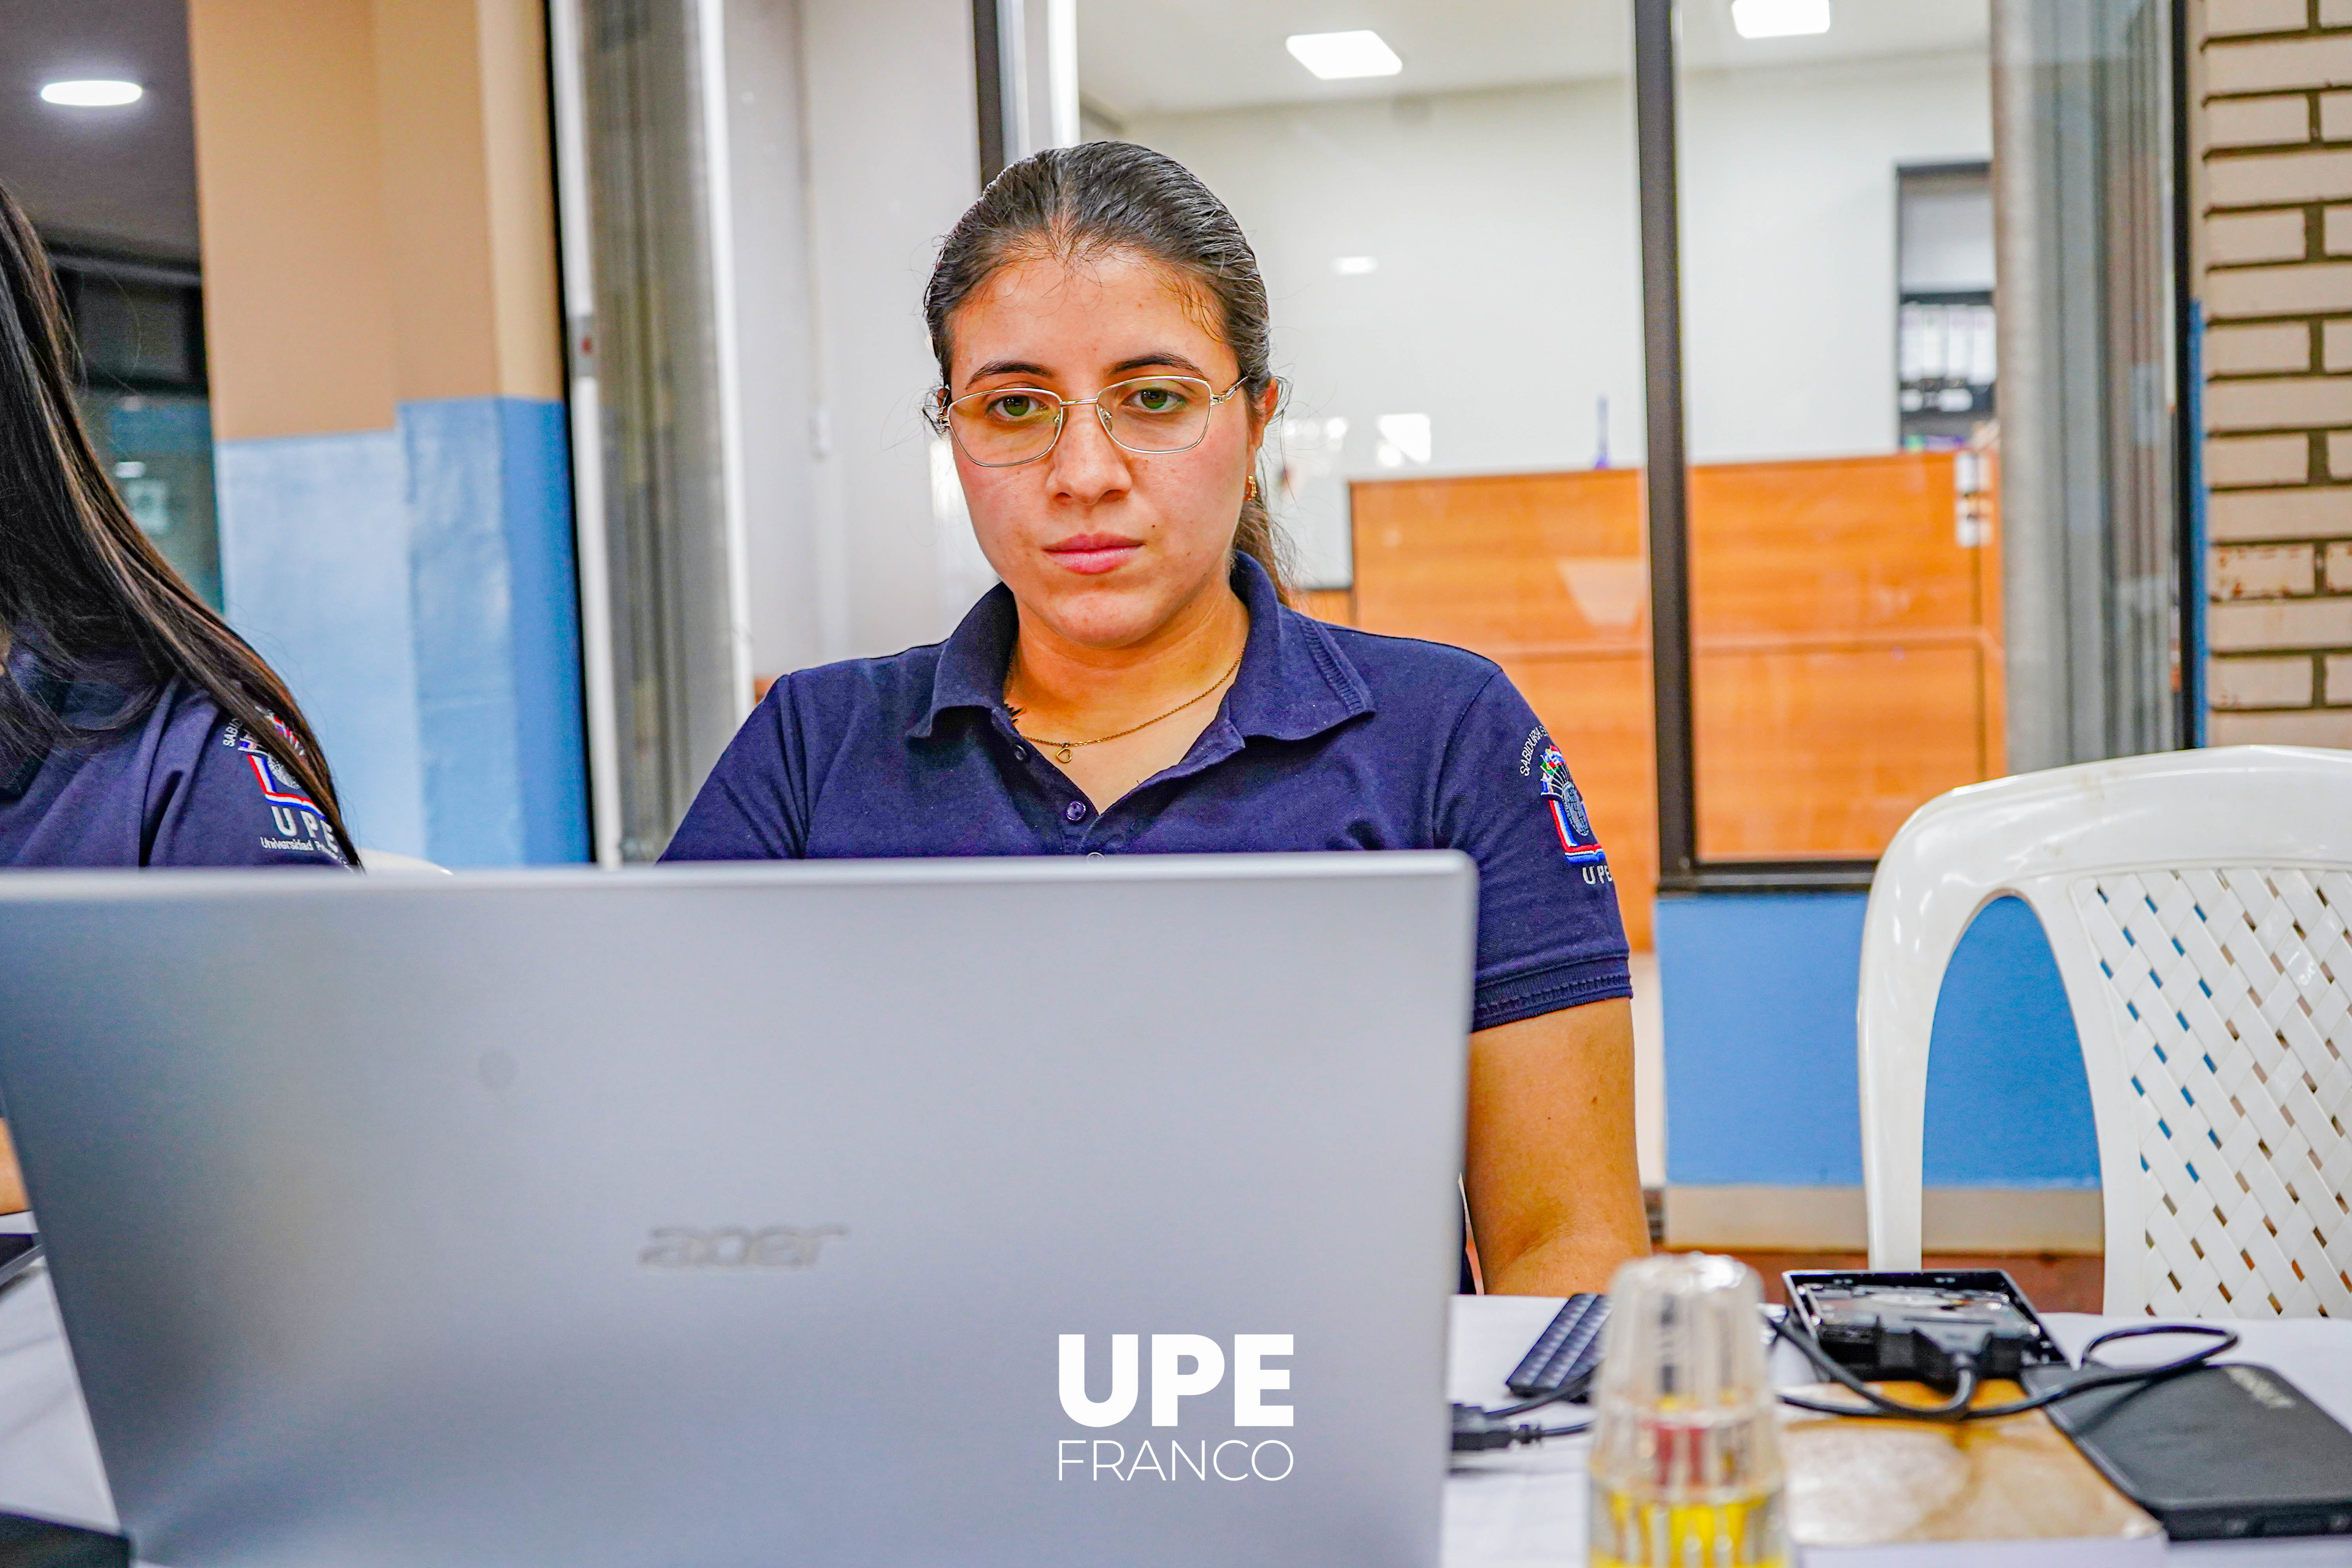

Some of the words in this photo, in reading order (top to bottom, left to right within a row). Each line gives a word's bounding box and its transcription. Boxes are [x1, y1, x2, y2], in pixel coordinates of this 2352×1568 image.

[260, 837, 314, 851] Universidad
[271, 806, 339, 853] UPE
[636, 1222, 851, 1268] acer
